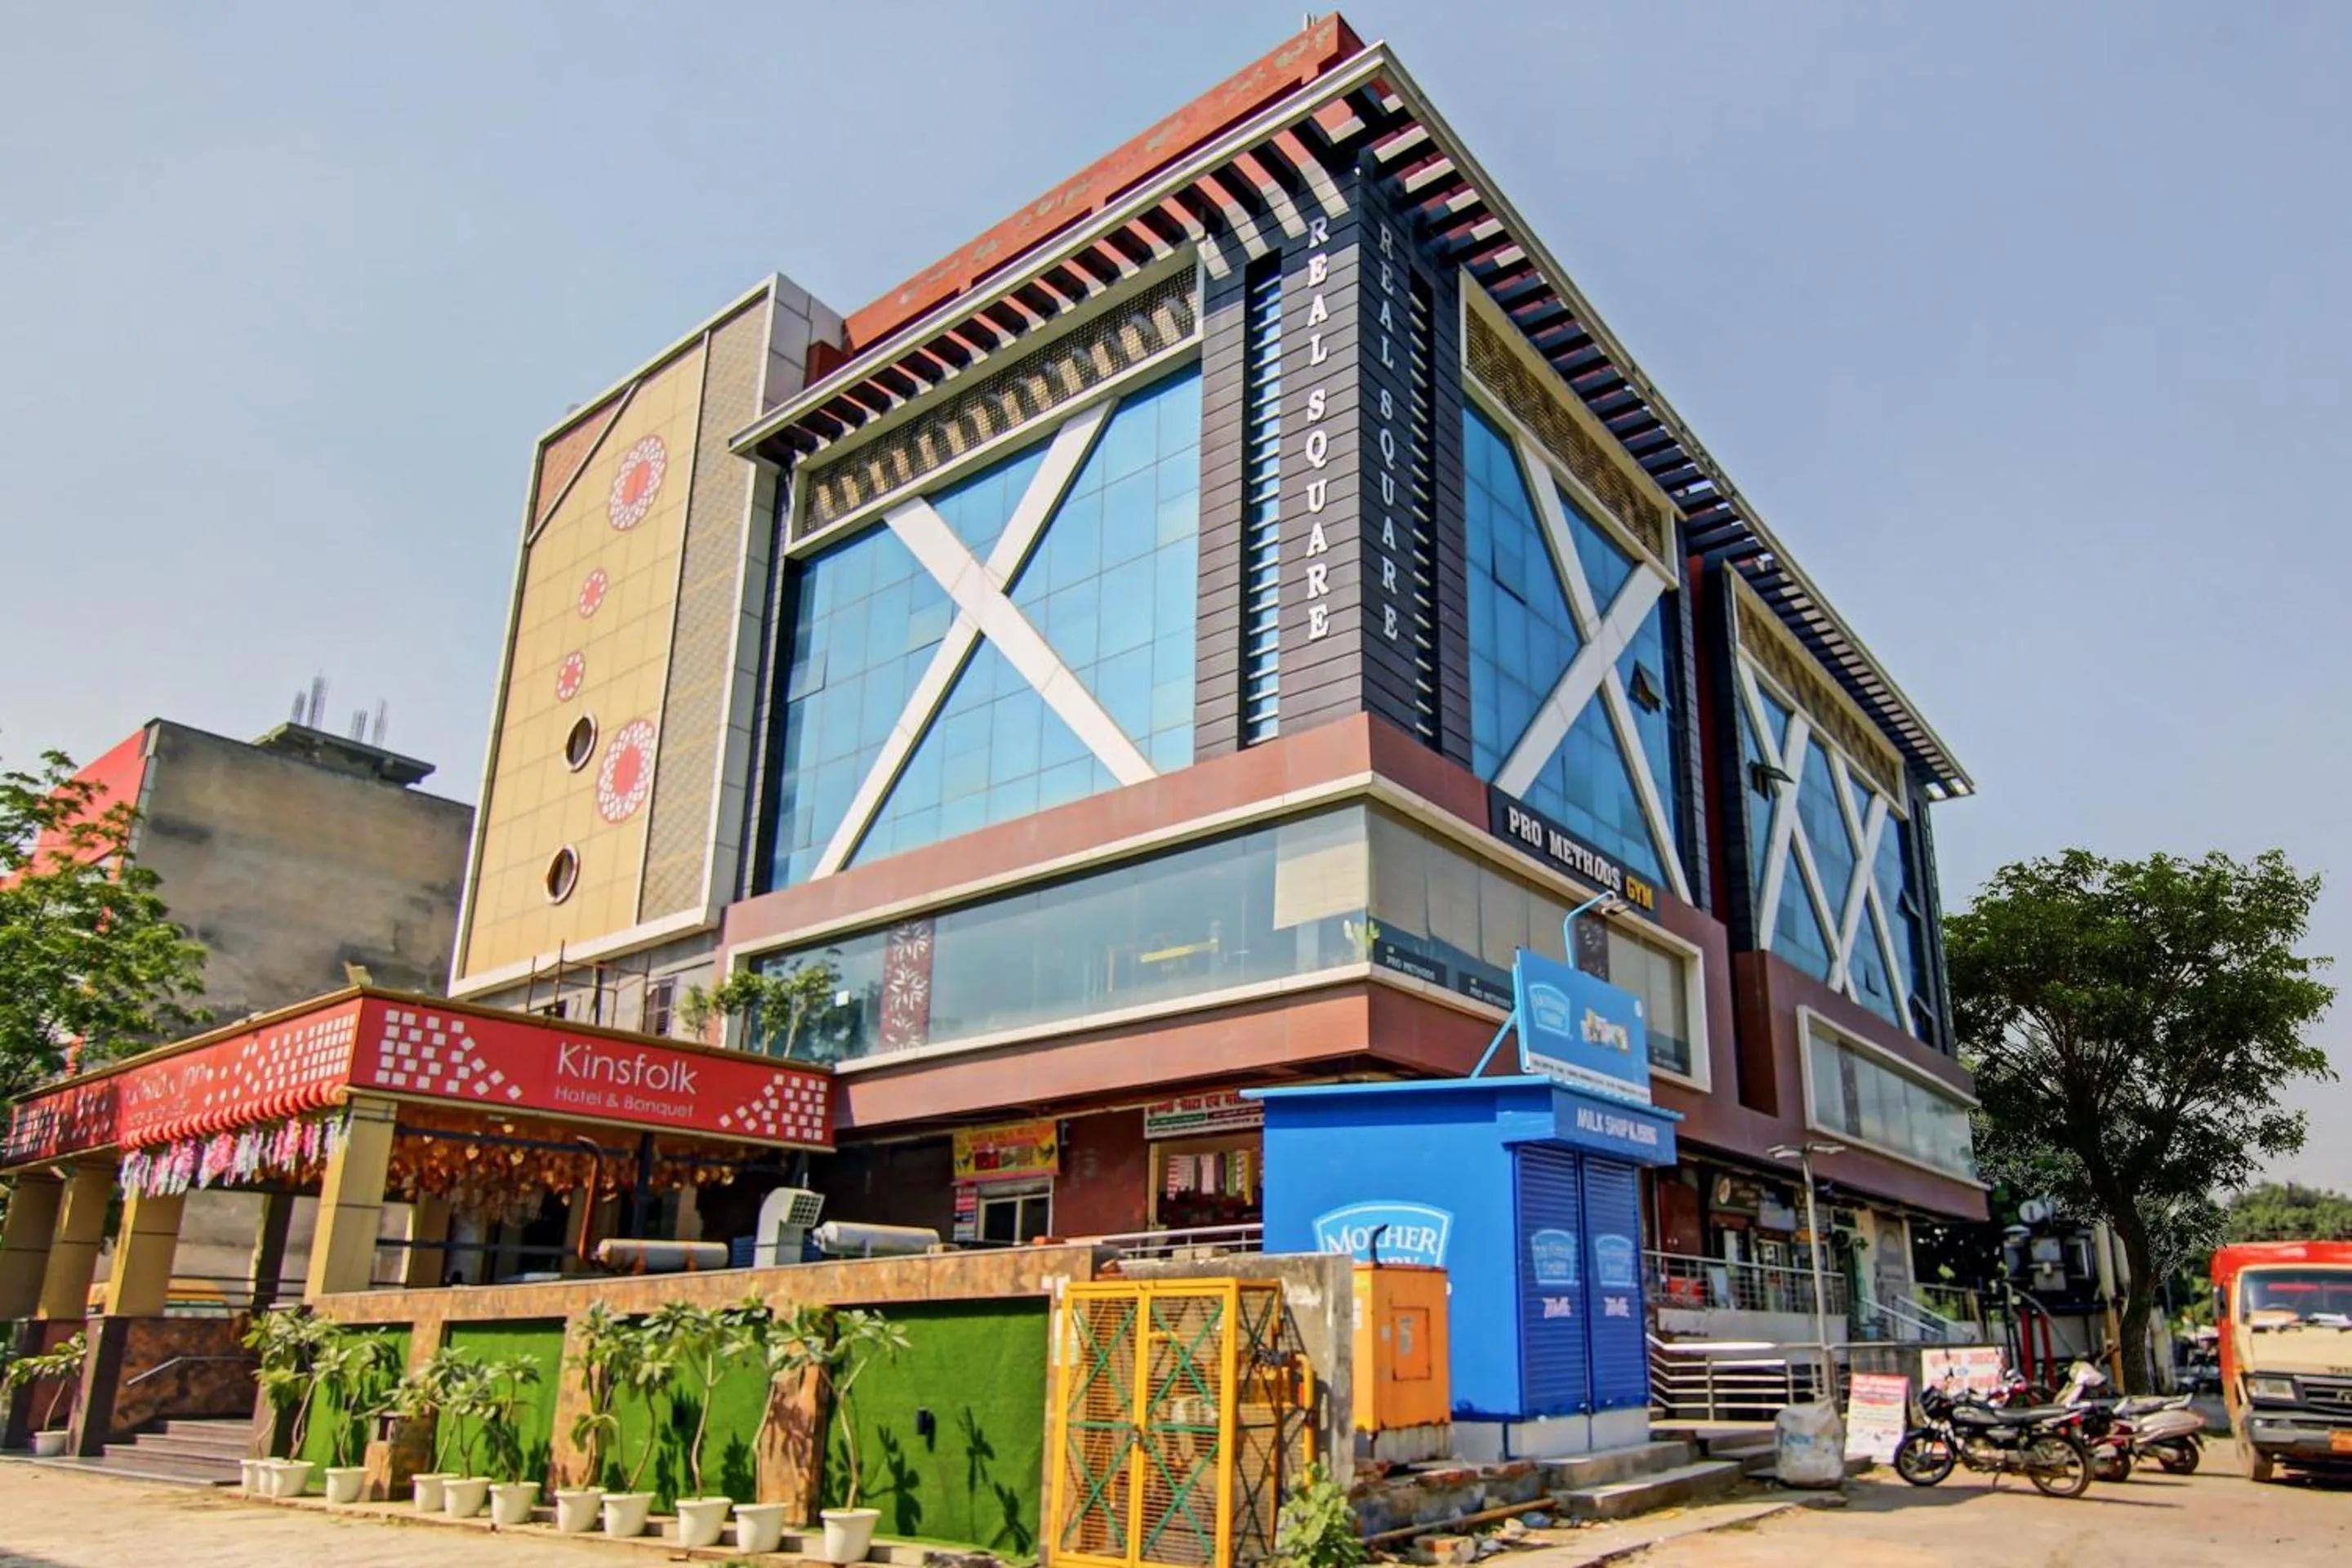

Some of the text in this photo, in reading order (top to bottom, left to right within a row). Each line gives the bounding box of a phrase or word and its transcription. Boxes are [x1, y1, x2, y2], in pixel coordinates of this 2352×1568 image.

[1306, 216, 1330, 641] REAL SQUARE
[1379, 223, 1398, 641] REAL SQUARE
[1508, 805, 1655, 910] PRO METHODS GYM
[555, 1085, 694, 1118] Hotel & Banquet
[557, 1041, 698, 1095] Kinsfolk
